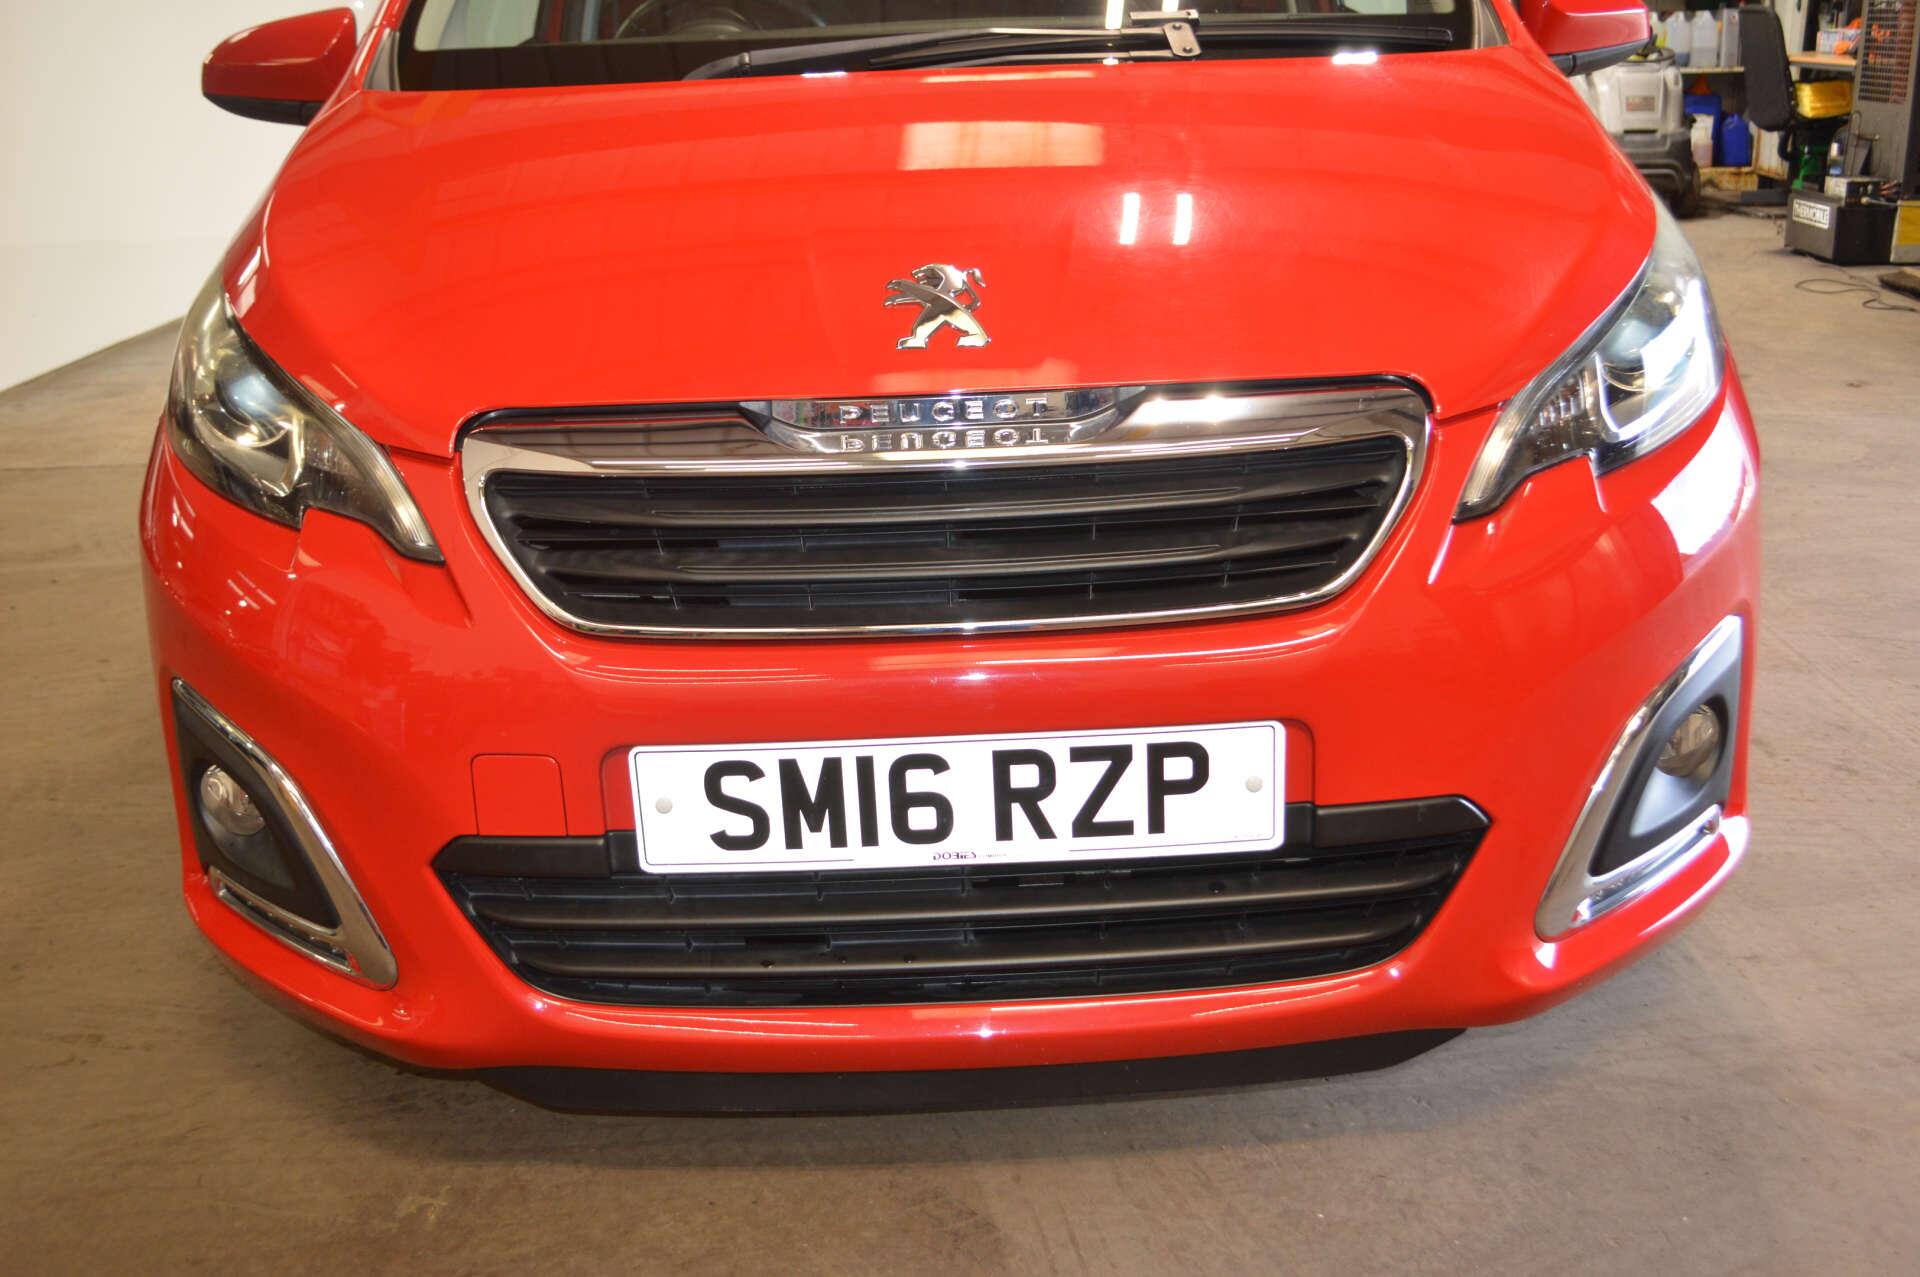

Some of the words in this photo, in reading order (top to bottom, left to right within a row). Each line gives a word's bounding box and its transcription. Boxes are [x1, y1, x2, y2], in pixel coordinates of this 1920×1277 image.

[839, 397, 1048, 423] PEUGEOT
[703, 753, 954, 851] SM16
[992, 740, 1210, 842] RZP
